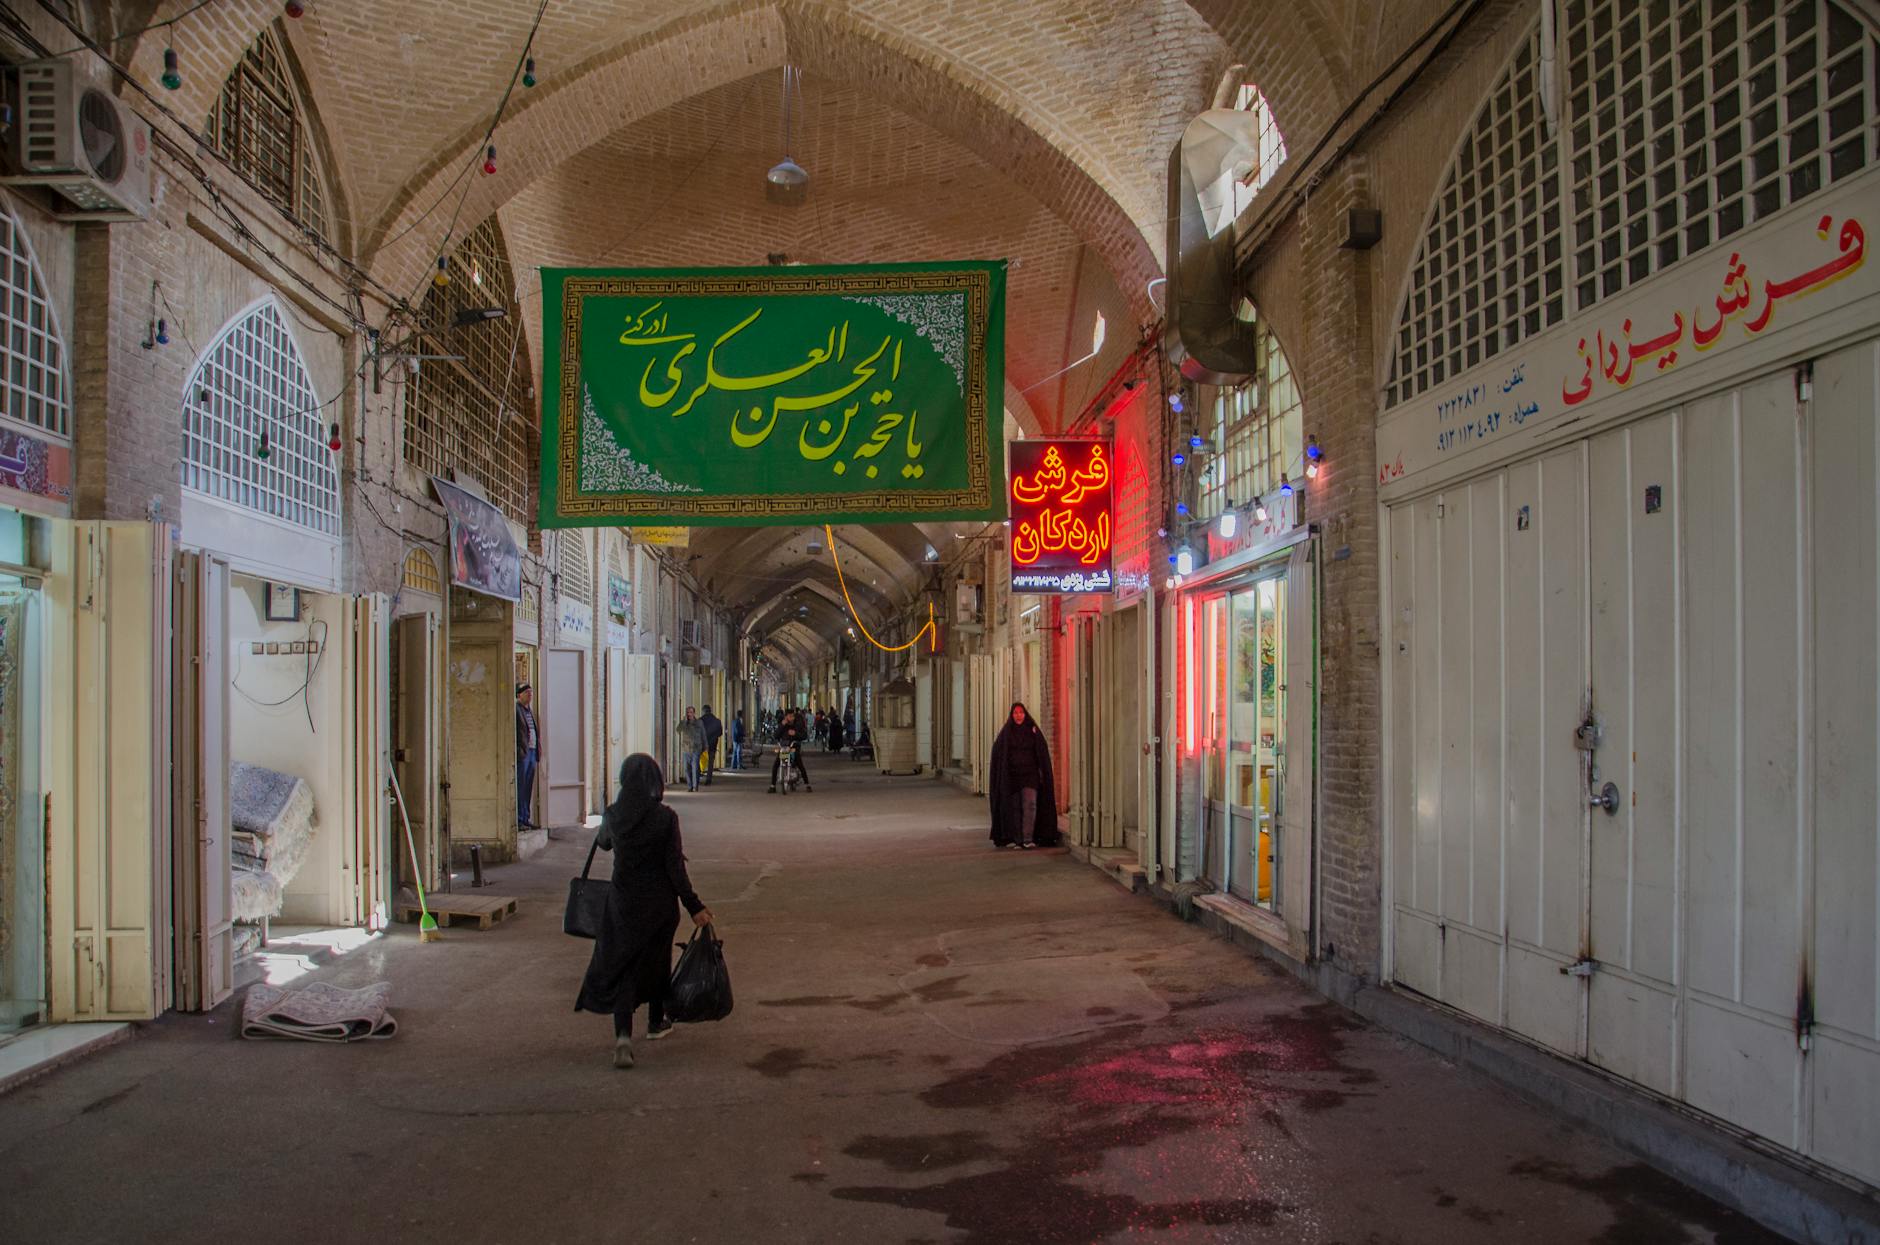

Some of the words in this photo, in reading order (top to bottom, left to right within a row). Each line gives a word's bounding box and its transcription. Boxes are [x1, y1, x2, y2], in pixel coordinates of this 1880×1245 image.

[1693, 215, 1866, 349] فرش
[639, 309, 849, 417] العسکری
[730, 335, 902, 448] الحسن
[1562, 313, 1685, 406] یزدانی
[798, 400, 860, 475] بن
[902, 411, 924, 479] یا
[1013, 444, 1109, 503] فرش
[1013, 508, 1109, 563] اردکان
